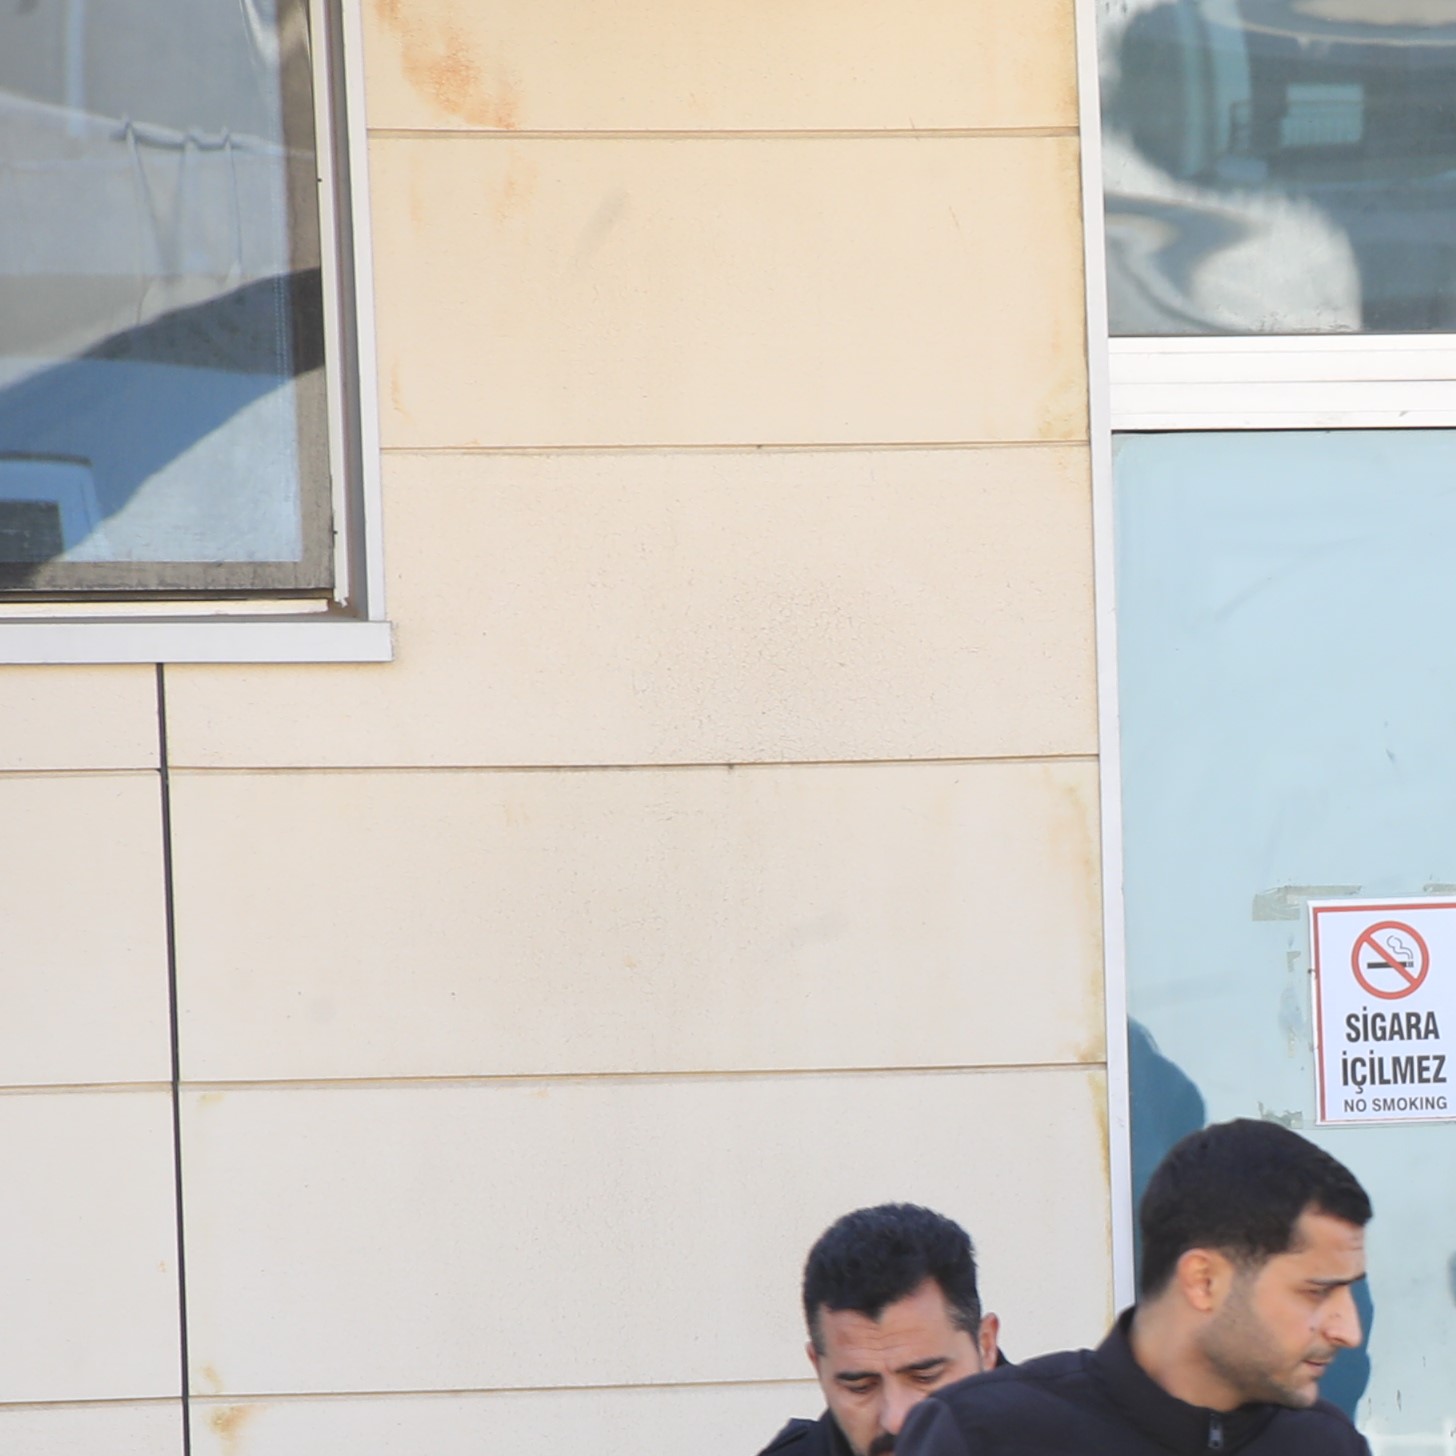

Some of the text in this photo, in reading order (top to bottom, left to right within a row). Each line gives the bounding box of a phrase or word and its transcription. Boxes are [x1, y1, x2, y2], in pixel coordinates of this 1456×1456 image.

[1345, 1006, 1440, 1042] SİGARA
[1341, 1050, 1447, 1094] İÇİLMEZ
[1343, 1096, 1448, 1113] NO SMOKING
